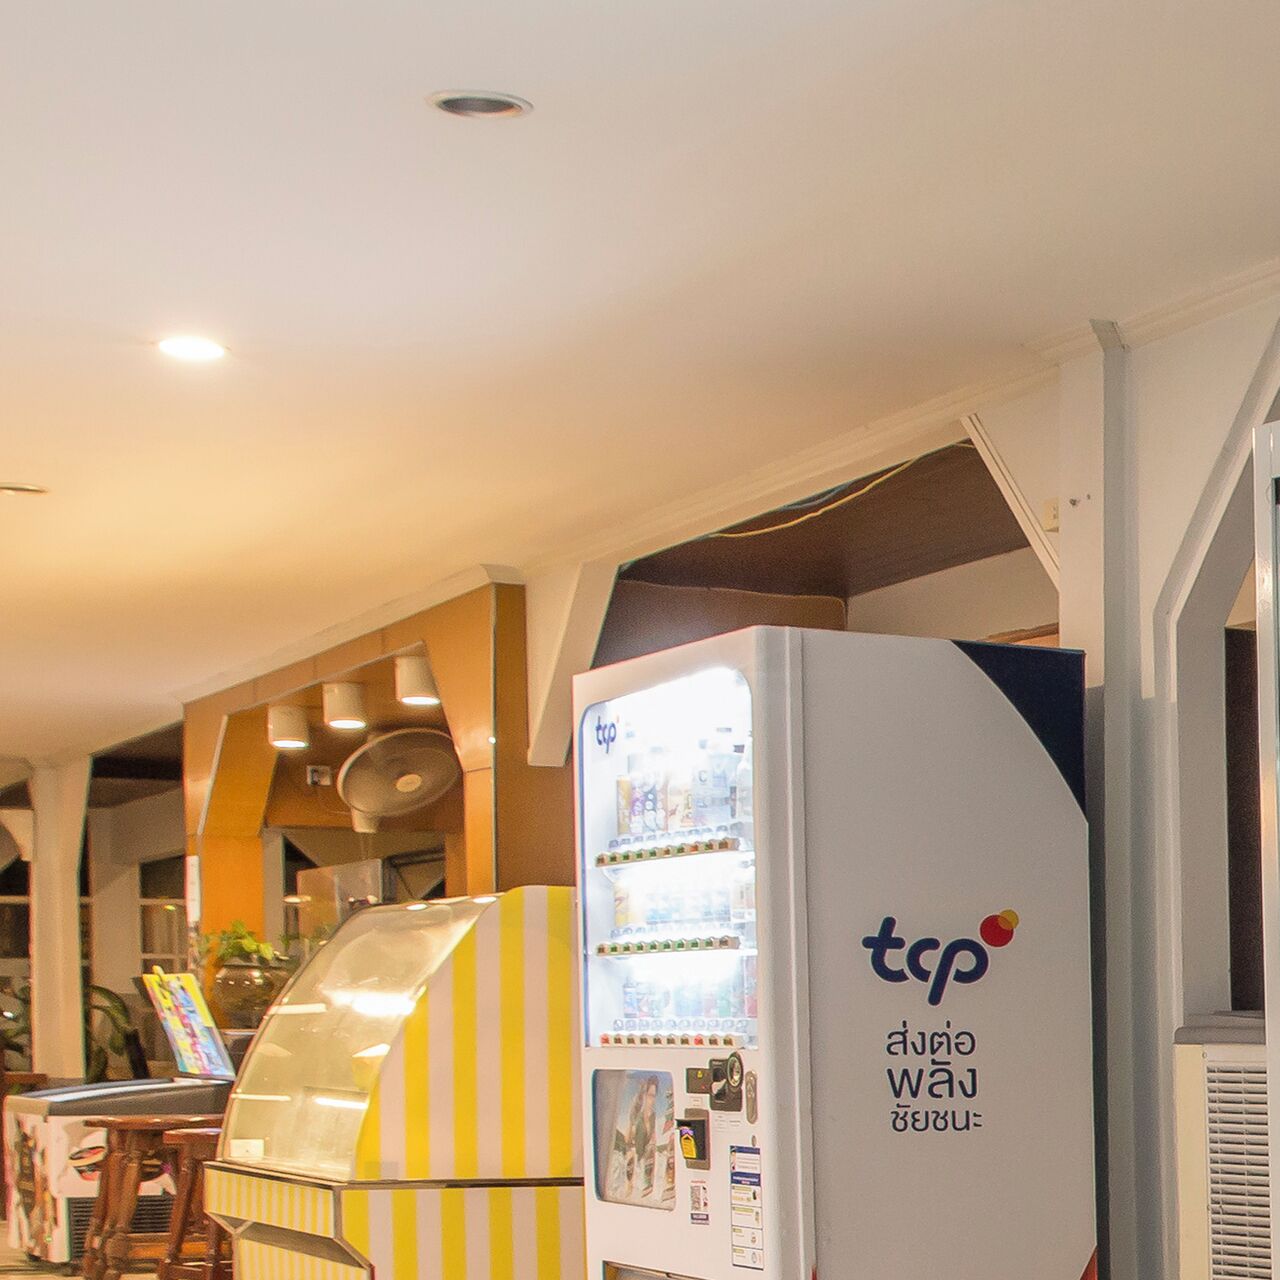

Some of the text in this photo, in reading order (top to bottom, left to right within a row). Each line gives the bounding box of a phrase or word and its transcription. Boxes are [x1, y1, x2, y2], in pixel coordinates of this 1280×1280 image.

[596, 715, 617, 754] tcp
[862, 916, 989, 1005] tcp
[887, 1020, 976, 1057] ส่งต่อ
[888, 1057, 978, 1099] พลัง
[890, 1103, 982, 1132] ชัยชนะ
